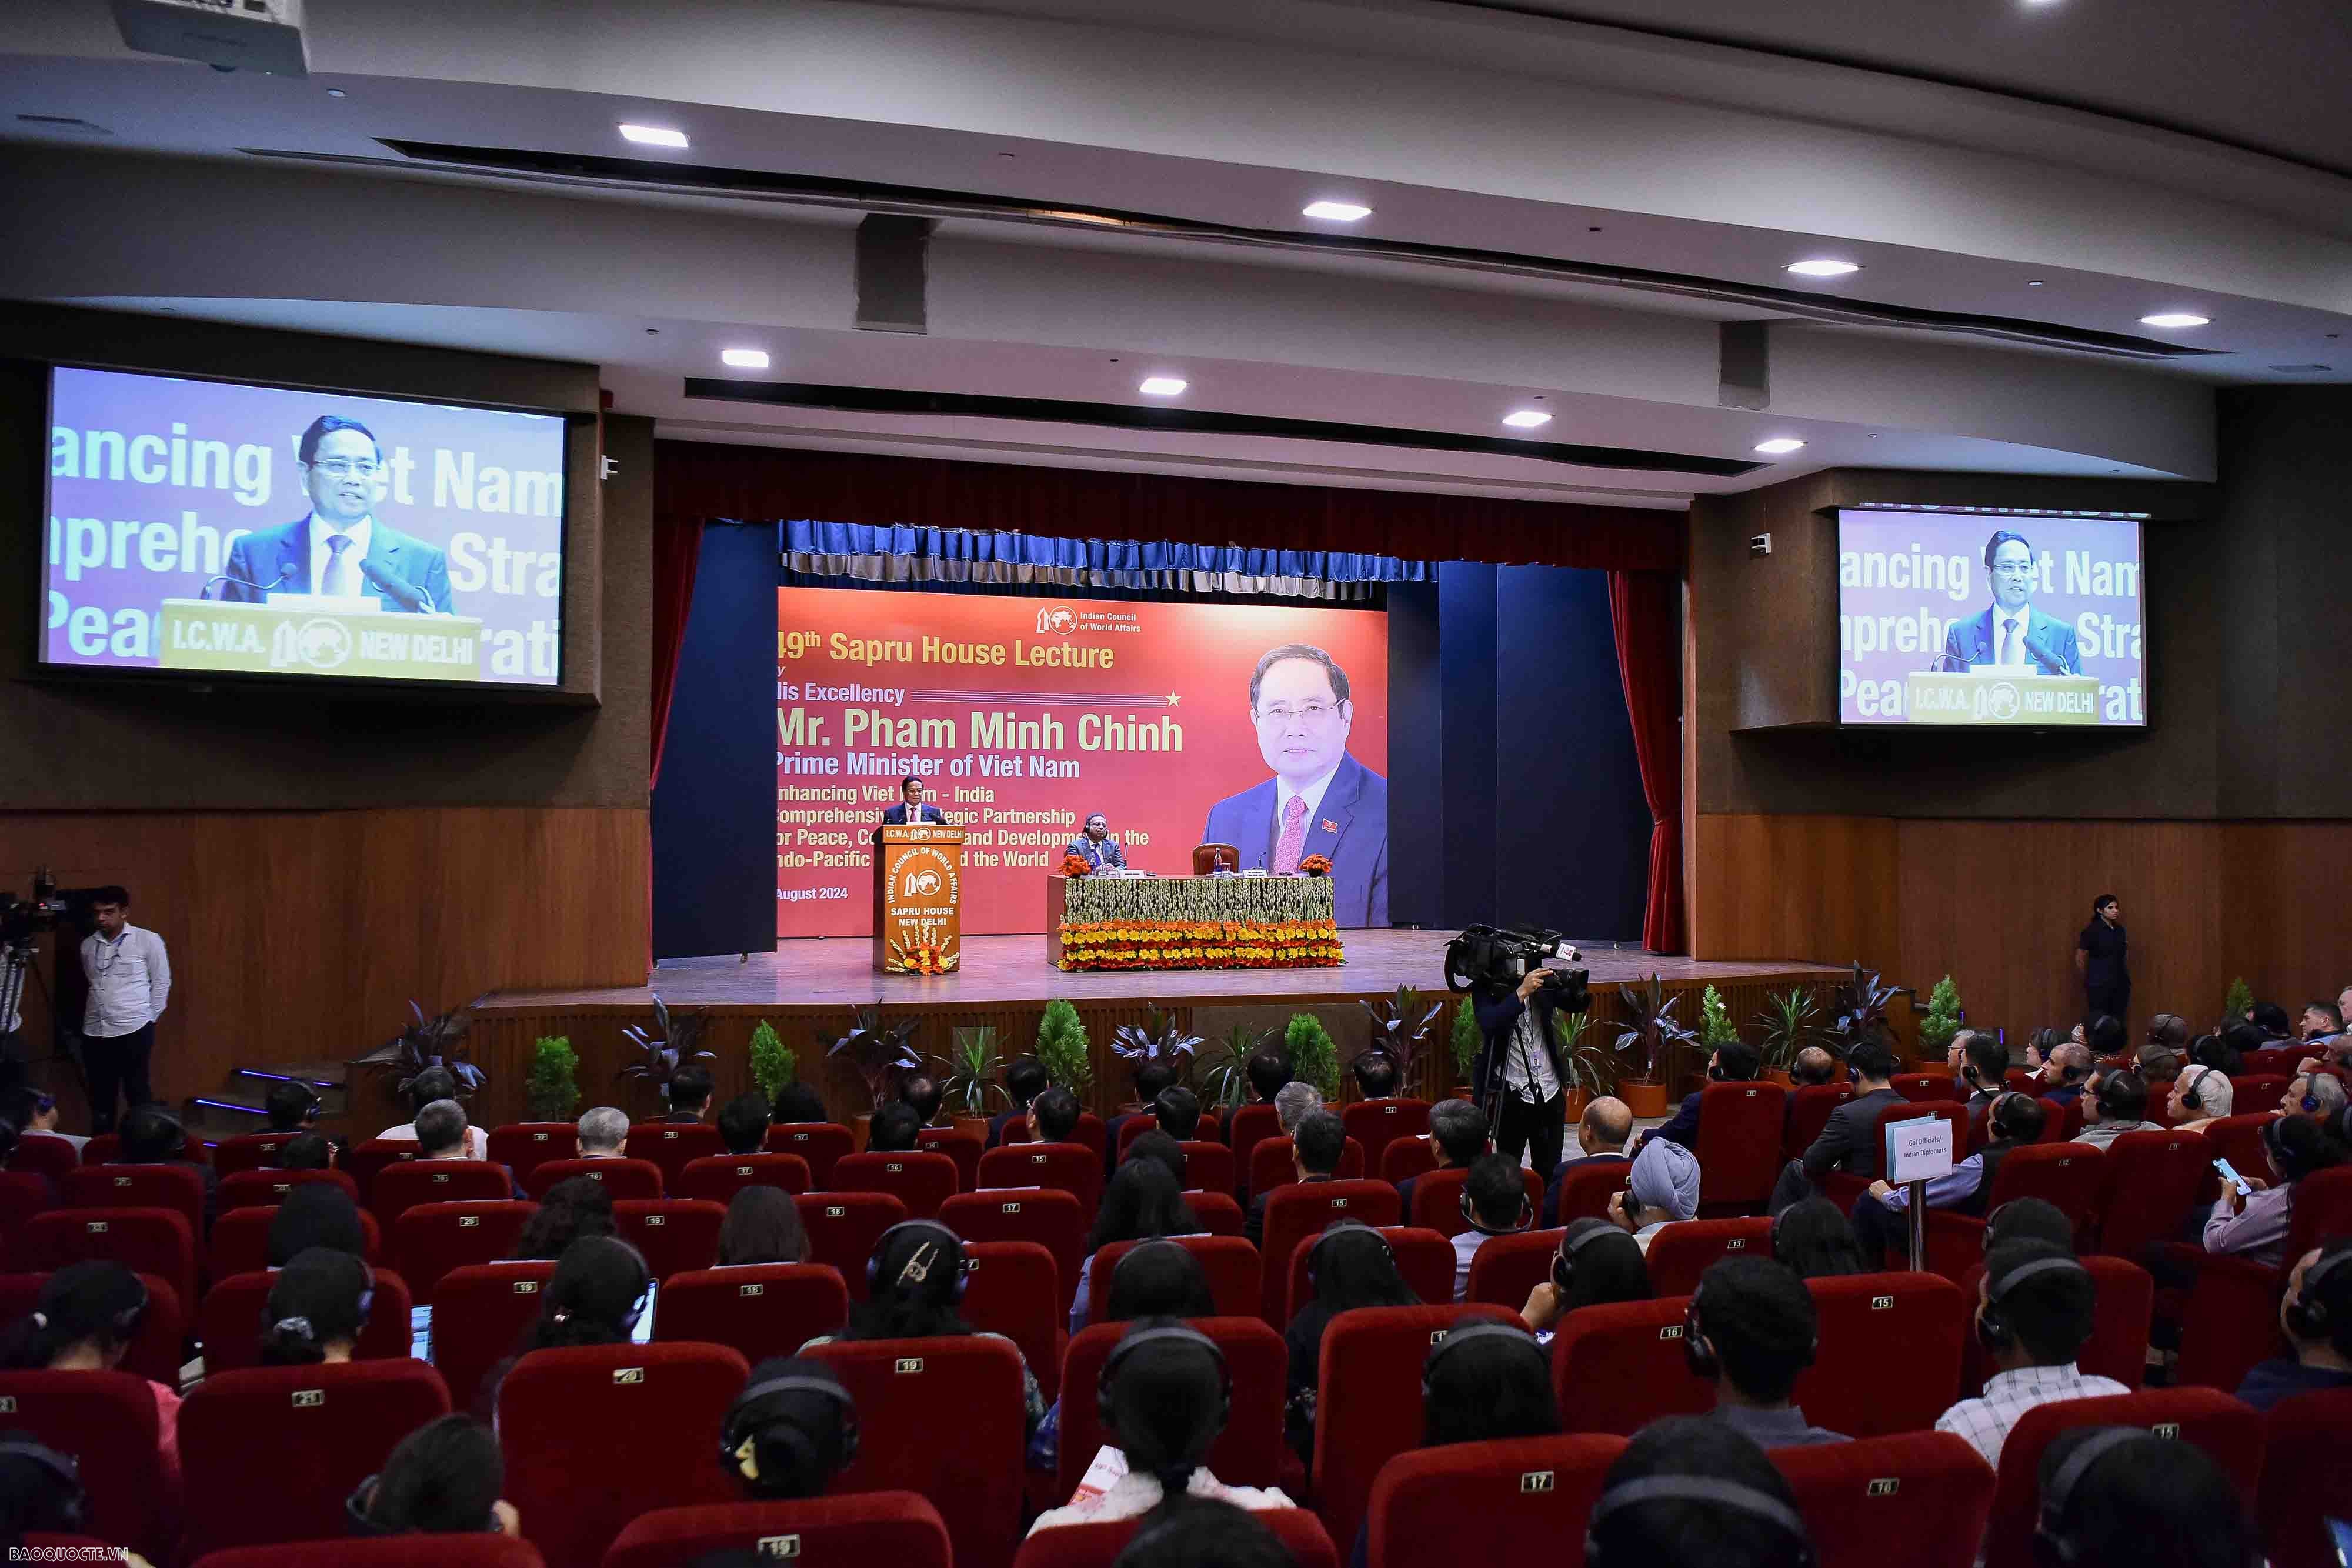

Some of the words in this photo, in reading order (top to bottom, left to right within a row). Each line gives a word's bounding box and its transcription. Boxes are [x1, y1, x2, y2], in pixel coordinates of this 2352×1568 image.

[1080, 612, 1104, 620] Indian
[1107, 613, 1136, 622] Council
[359, 630, 410, 661] NEW
[412, 633, 475, 665] DELHI
[829, 632, 913, 667] Sapru
[922, 636, 1006, 665] House
[1015, 639, 1115, 669] Lecture
[805, 682, 905, 707] Excellency
[2024, 690, 2055, 713] NEW
[2057, 692, 2094, 714] DELHI
[777, 707, 830, 746] Mr.
[845, 709, 956, 748] Pham
[970, 712, 1065, 750] Minh
[1078, 713, 1183, 752] Chinh
[846, 752, 944, 776] Minister
[950, 753, 973, 777] of
[979, 754, 1023, 778] Viet
[1029, 755, 1080, 778] Nam
[778, 785, 858, 805] nhancing
[862, 785, 895, 802] Viet
[955, 786, 995, 803] India
[983, 808, 1076, 828] Partnership
[797, 829, 853, 848] Peace,
[963, 829, 992, 846] and
[1124, 829, 1149, 846] the
[933, 830, 948, 838] NEW
[973, 850, 999, 867] the
[1003, 850, 1049, 867] World
[887, 875, 896, 903] INDIAN
[892, 848, 919, 873] COUNCIL
[920, 846, 931, 855] OF
[932, 848, 953, 871] WORLD
[949, 872, 959, 905] AFFAIRS
[819, 887, 848, 899] 2024
[891, 907, 921, 916] SAPRU
[923, 907, 955, 915] HOUSE
[899, 918, 918, 926] NEW
[920, 918, 947, 926] DELHI
[1920, 1147, 1947, 1157] Diplomats
[1879, 1299, 1889, 1307] 15
[1667, 1328, 1677, 1337] 16
[903, 1360, 917, 1370] 19
[1532, 1476, 1546, 1490] 17
